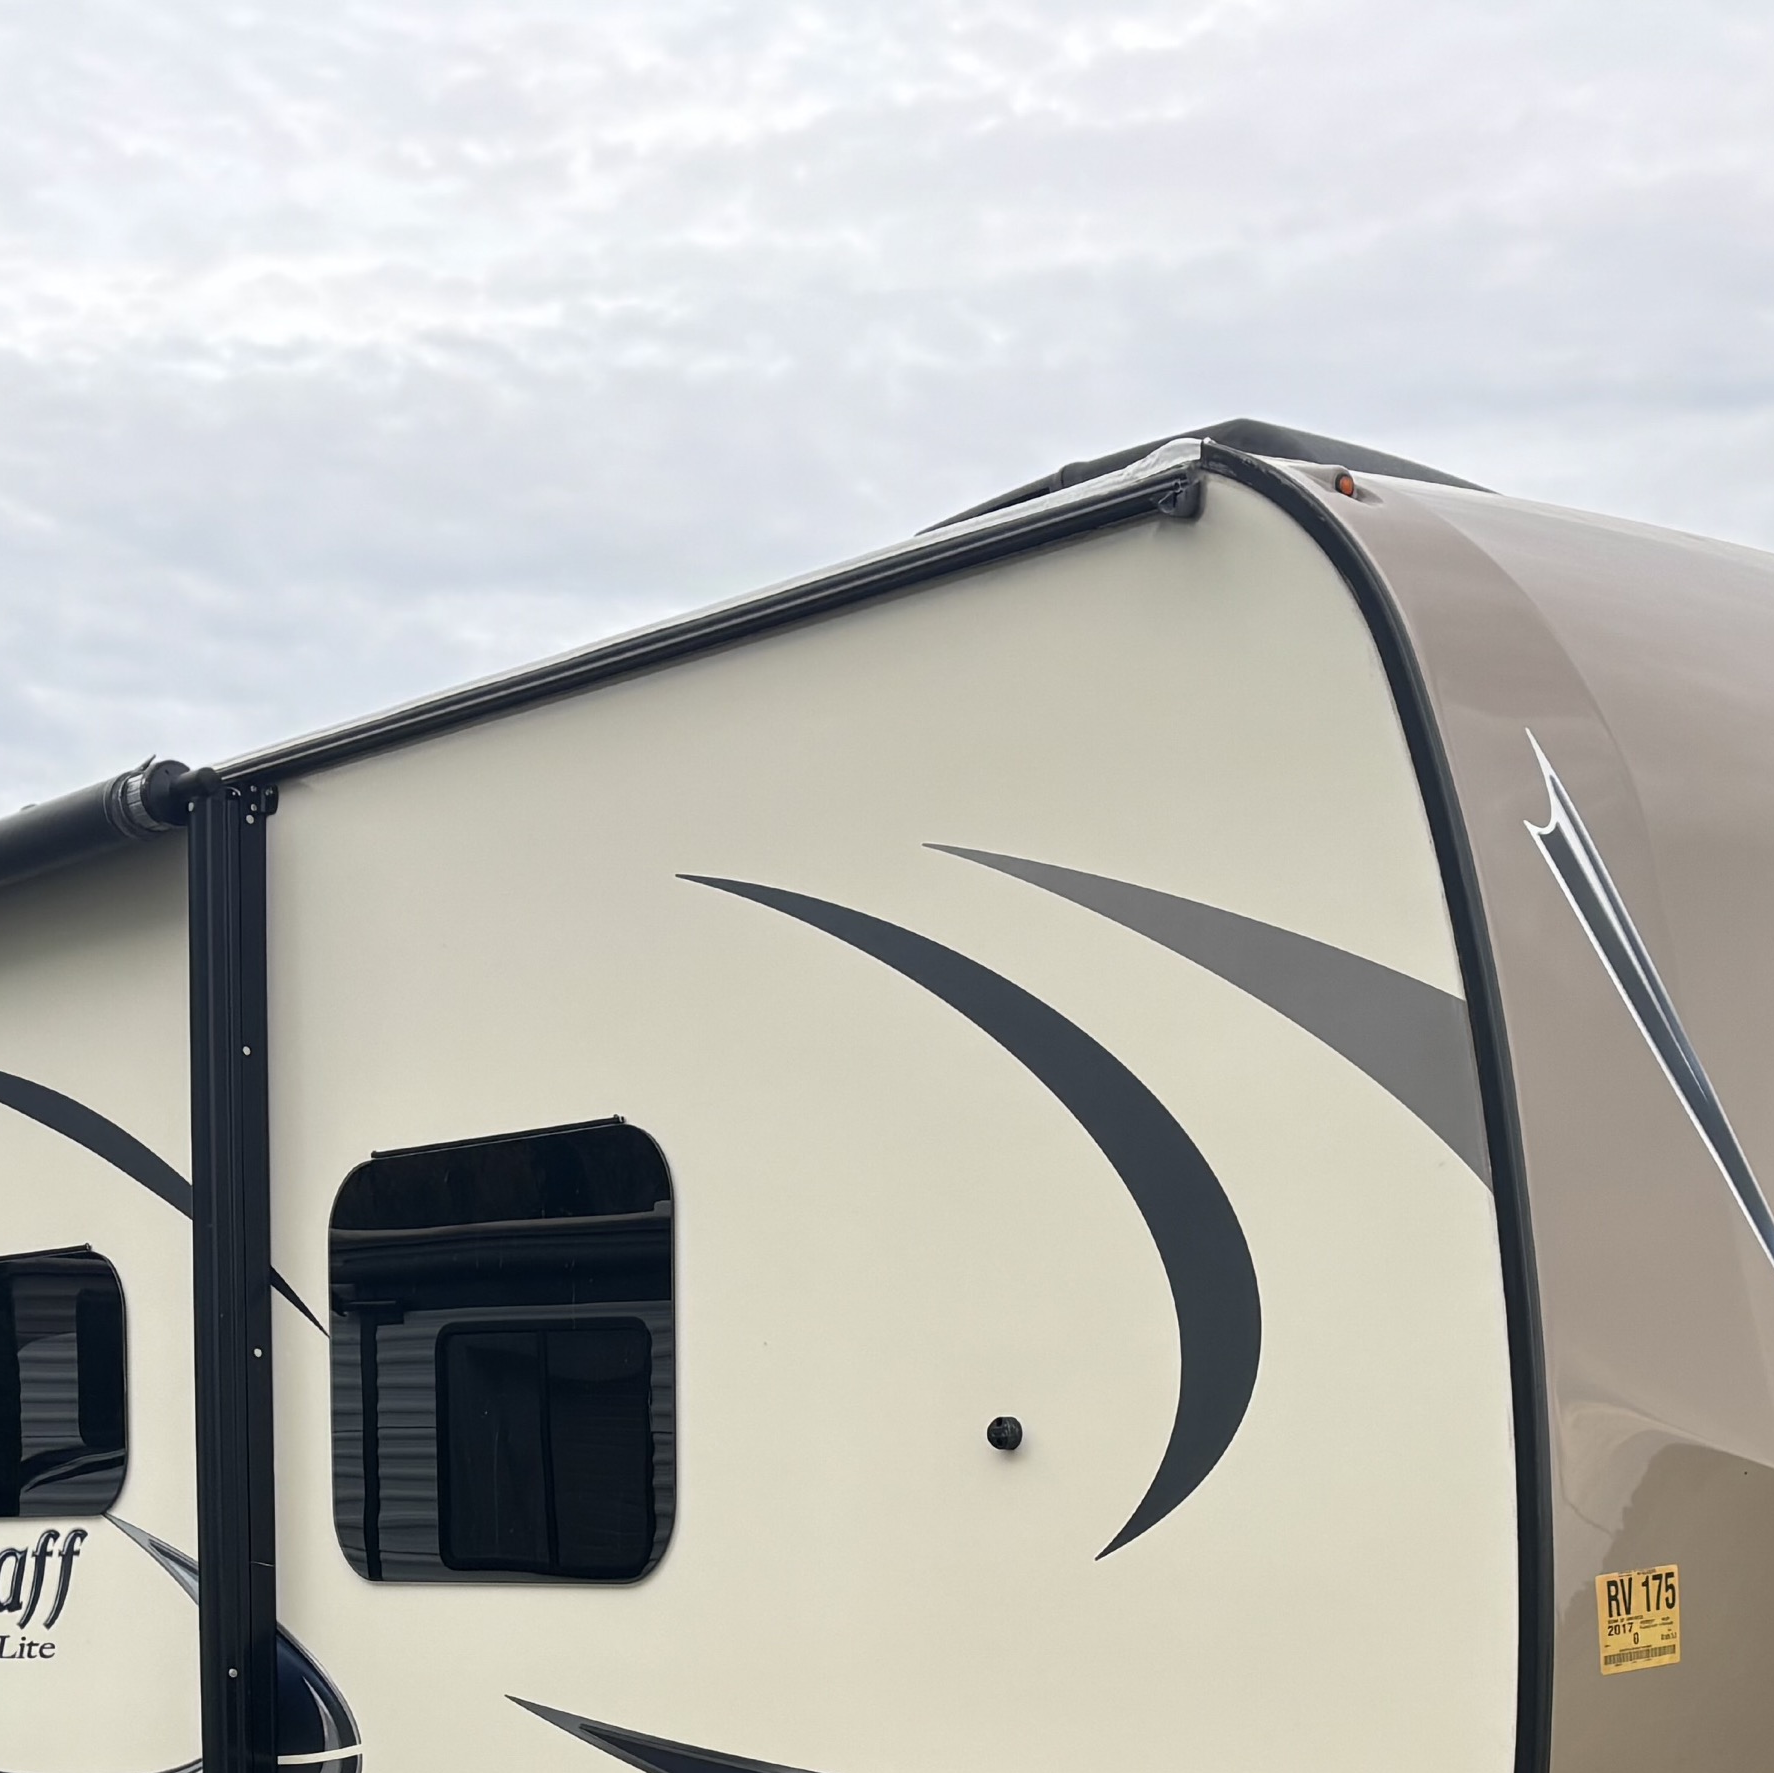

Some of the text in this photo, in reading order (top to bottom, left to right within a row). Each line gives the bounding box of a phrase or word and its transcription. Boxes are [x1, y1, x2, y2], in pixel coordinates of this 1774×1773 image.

[1606, 1571, 1676, 1618] RV 175
[1607, 1622, 1634, 1637] 2017
